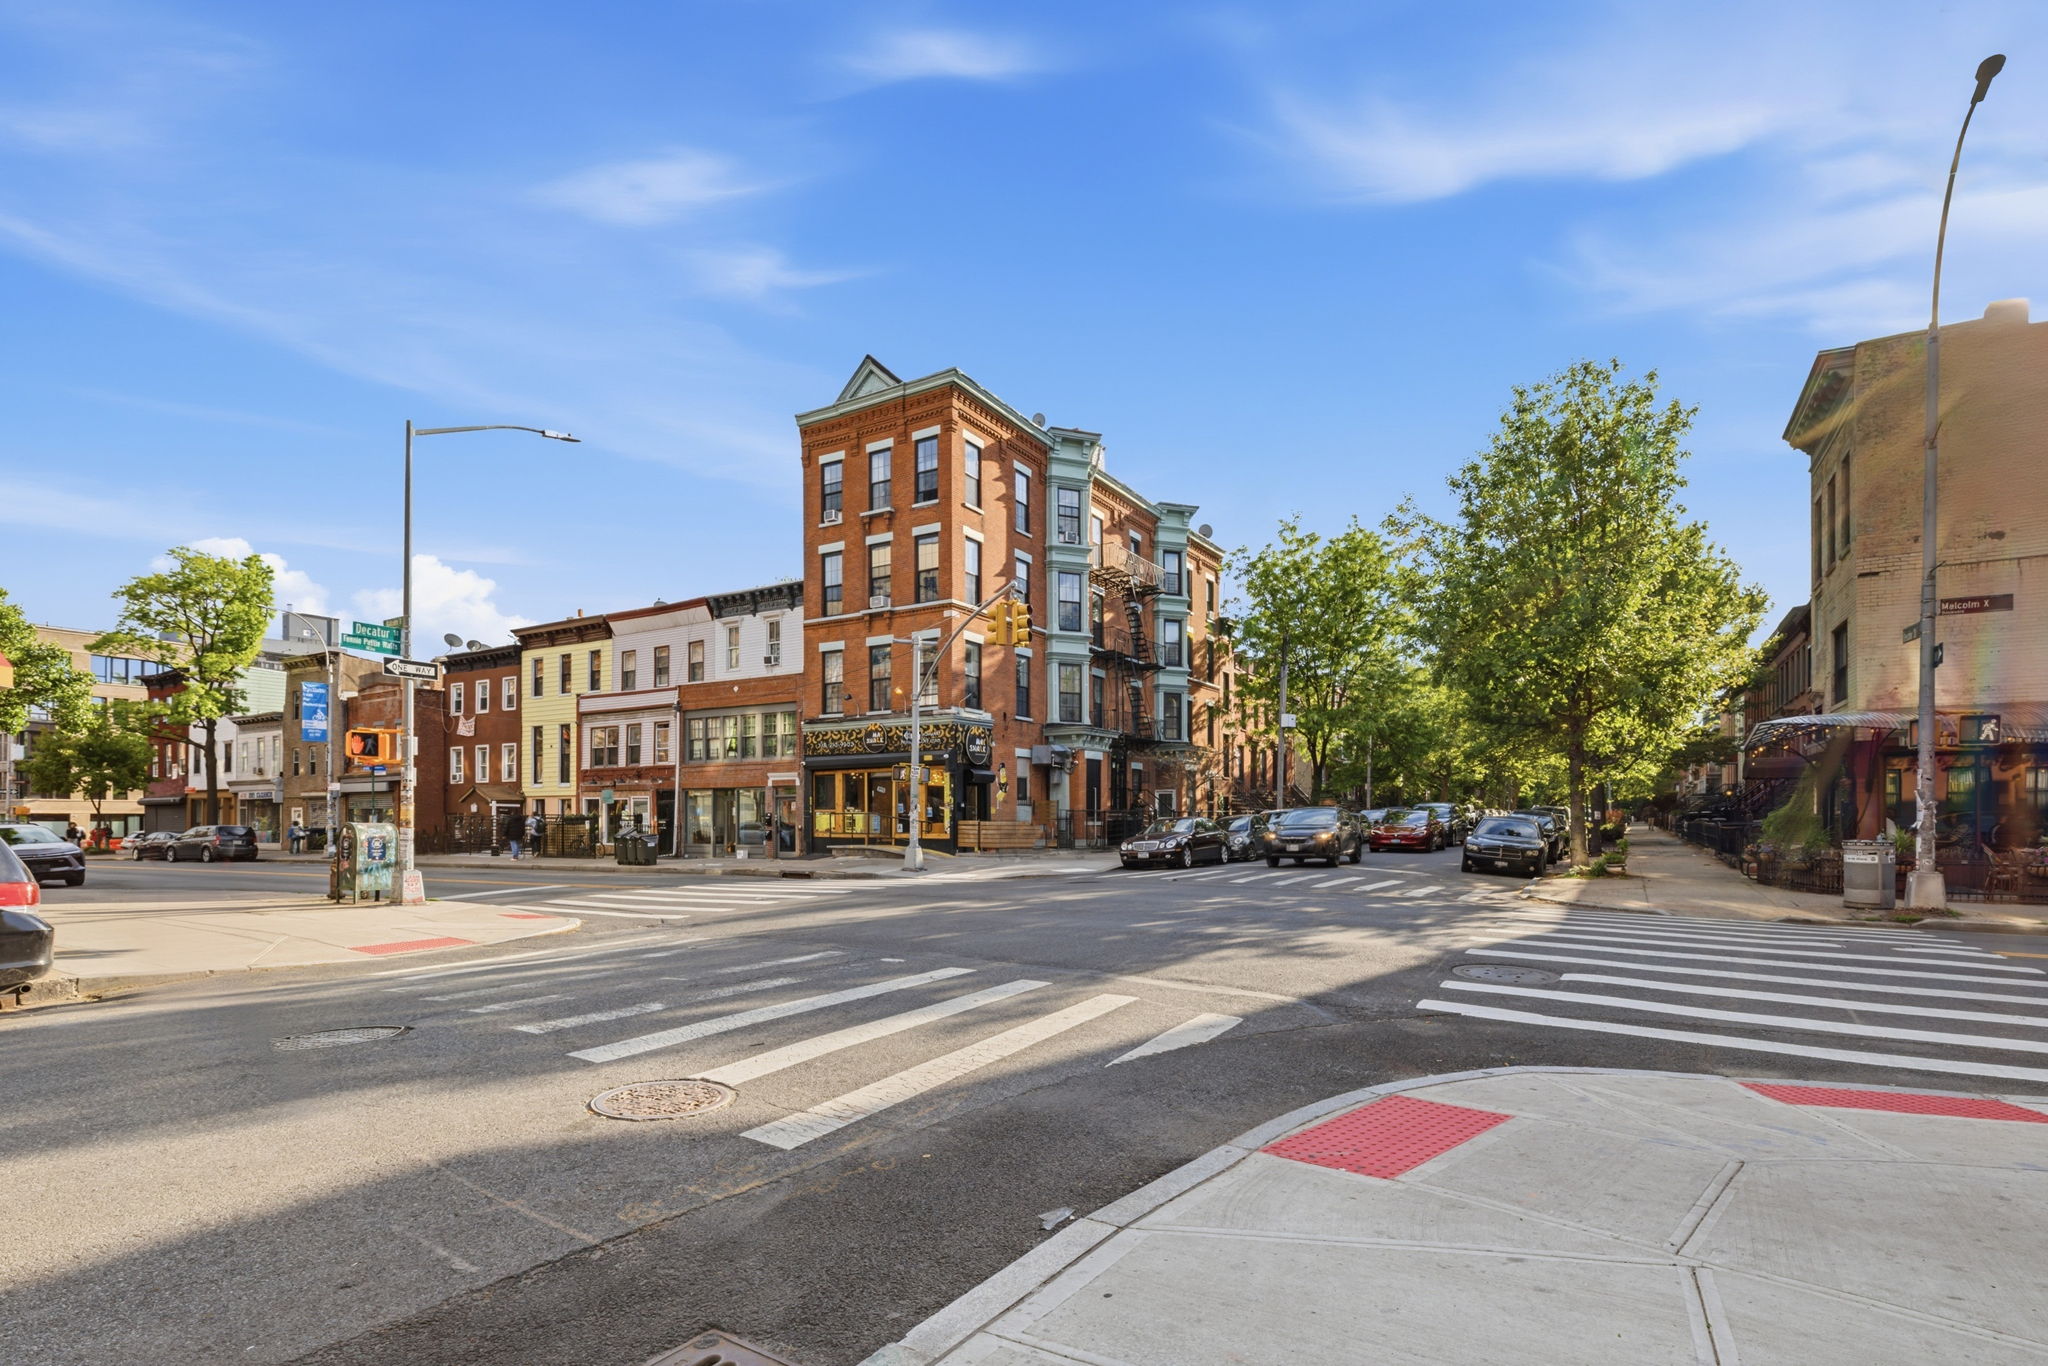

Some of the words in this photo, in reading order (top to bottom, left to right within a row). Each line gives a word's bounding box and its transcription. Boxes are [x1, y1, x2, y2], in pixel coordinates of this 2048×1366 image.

[1941, 601, 1980, 610] Malcolm
[1983, 599, 1990, 608] X
[355, 623, 390, 638] Decatur
[392, 663, 408, 672] ONE
[415, 666, 432, 675] WAY
